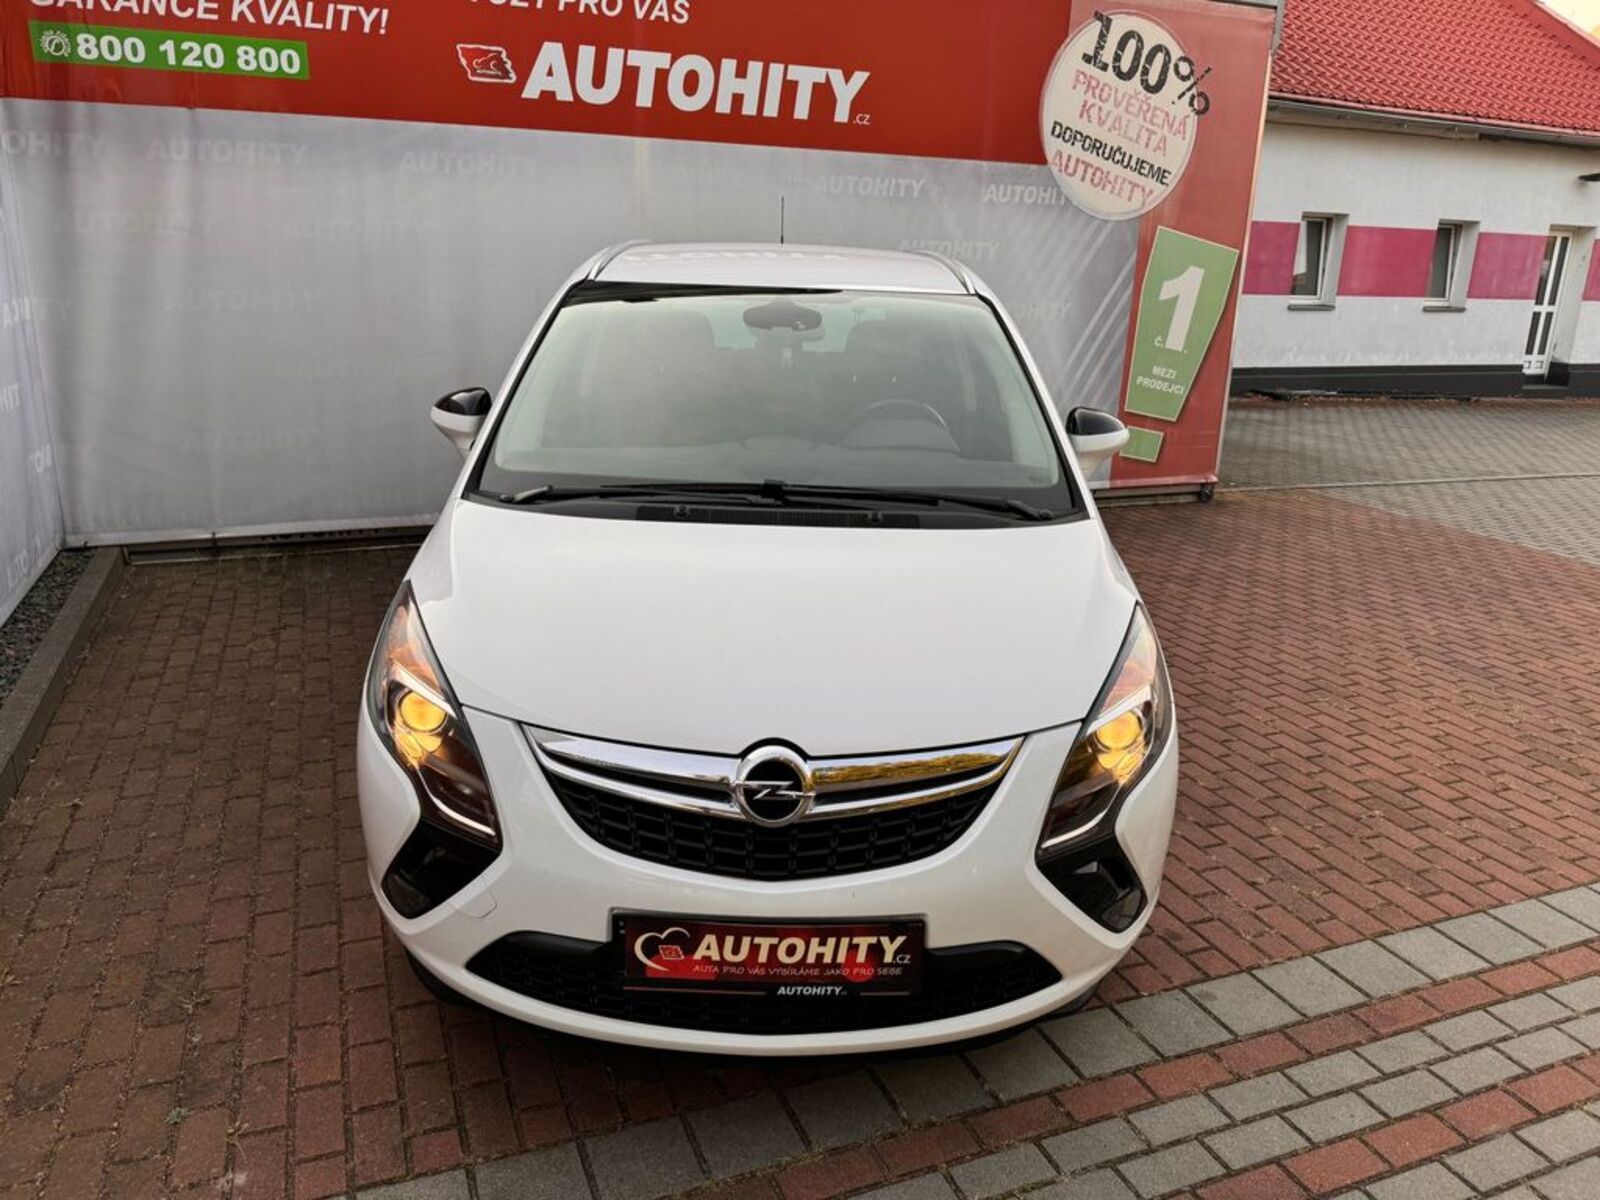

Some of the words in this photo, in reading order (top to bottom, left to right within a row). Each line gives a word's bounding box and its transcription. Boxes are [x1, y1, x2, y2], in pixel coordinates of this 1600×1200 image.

[231, 0, 389, 34] KVALITY!
[76, 33, 146, 63] 800
[159, 39, 225, 69] 120
[236, 45, 301, 75] 800
[1081, 10, 1212, 115] 100%
[1071, 70, 1191, 141] PROVĚŘENÁ
[1079, 100, 1168, 157] KVALITA
[1051, 121, 1173, 187] DOPORUČUJEME
[814, 174, 926, 198] AUTOHITY
[1051, 149, 1153, 206] AUTOHITY
[1136, 376, 1185, 396] PRODEJCI
[1152, 365, 1177, 380] MEZI
[723, 966, 744, 975] PRO
[824, 966, 849, 977] JAKO
[852, 967, 874, 976] PRO
